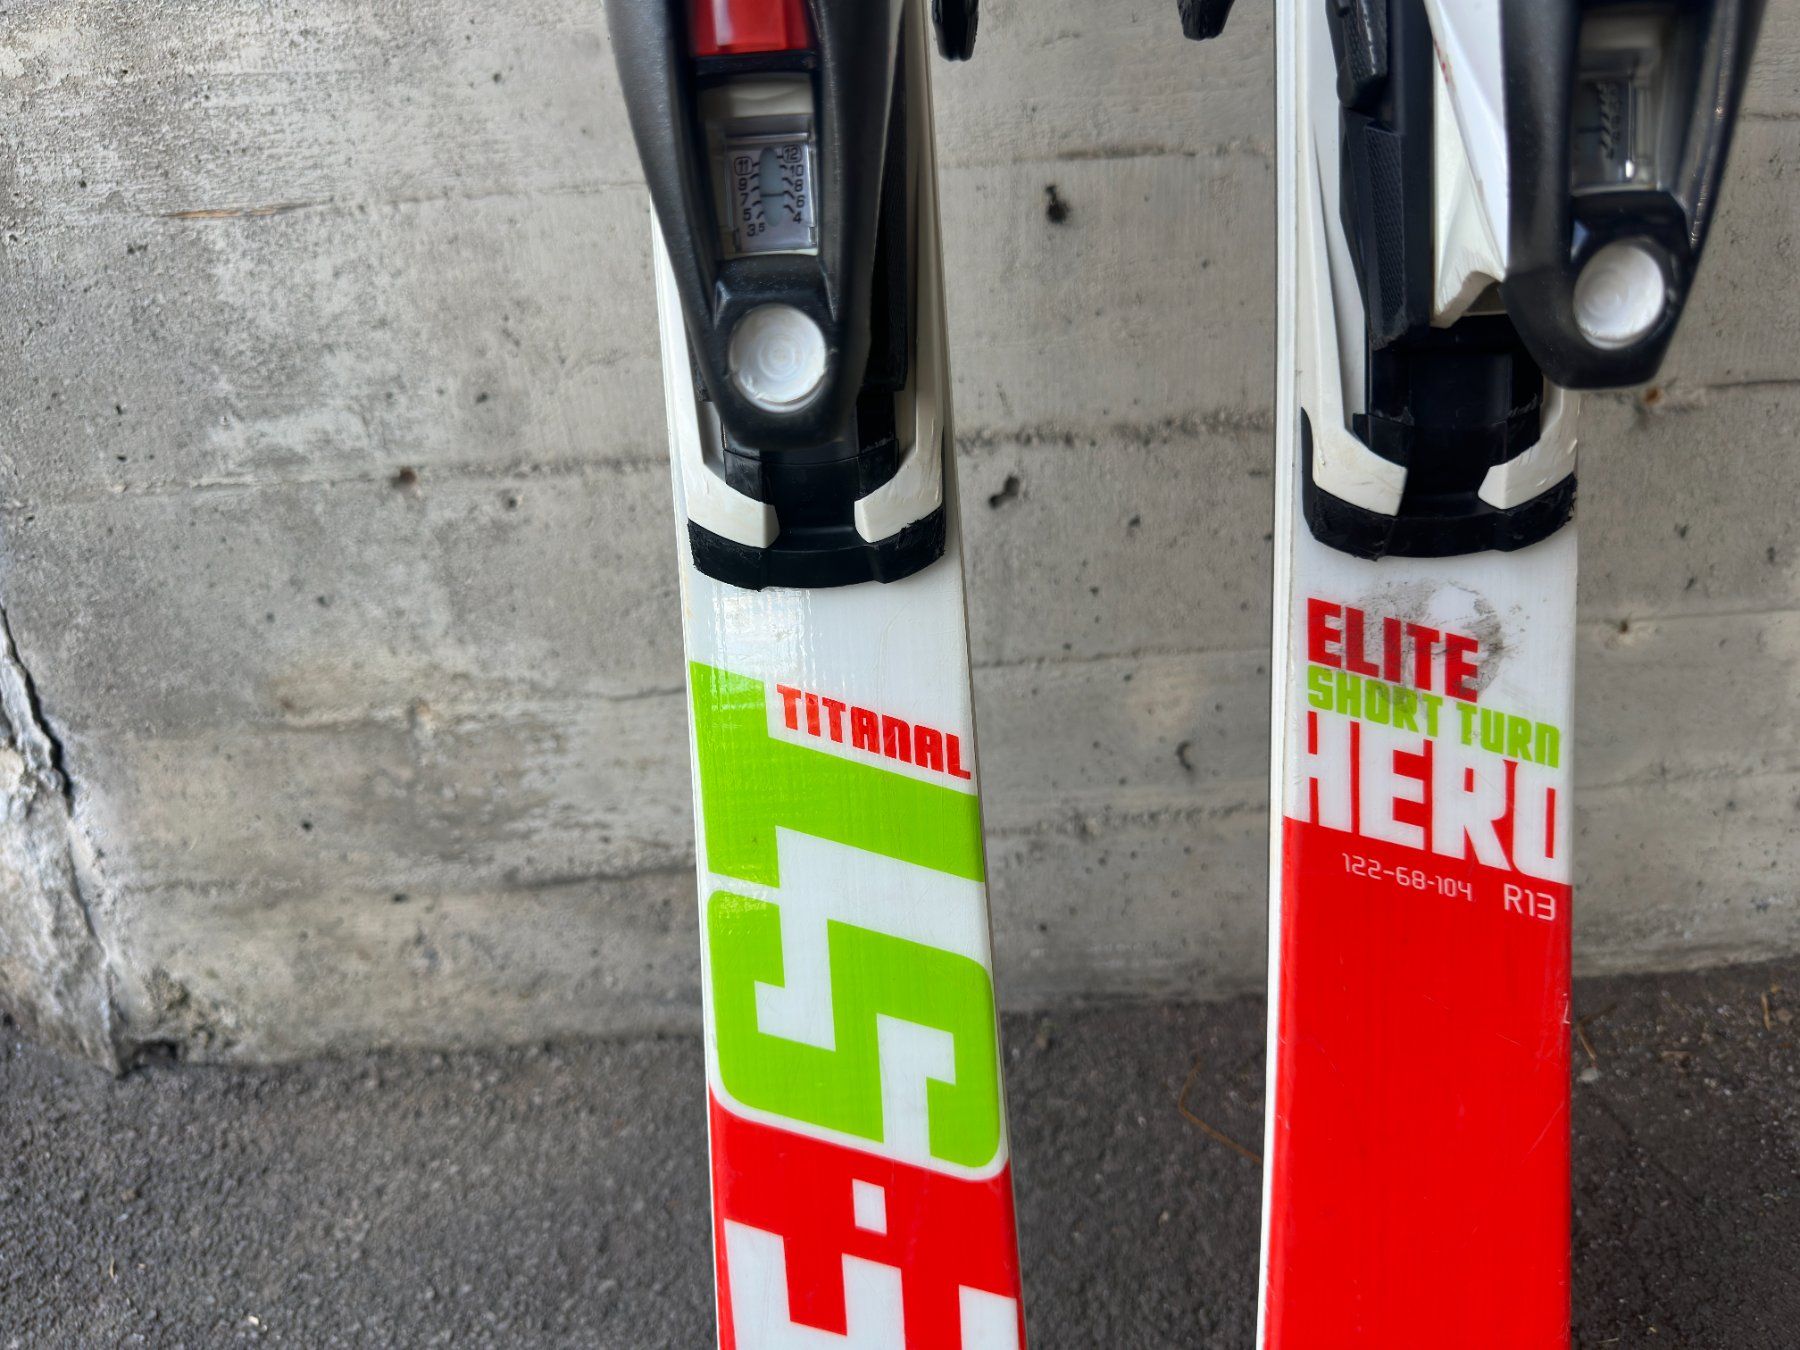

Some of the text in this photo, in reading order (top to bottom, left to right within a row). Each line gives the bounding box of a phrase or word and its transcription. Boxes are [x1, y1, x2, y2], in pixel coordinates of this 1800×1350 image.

[738, 178, 748, 191] 9
[790, 165, 804, 176] 10
[795, 179, 804, 192] 8
[793, 211, 802, 224] 4
[797, 195, 805, 208] 6
[1307, 597, 1478, 703] ELITE
[777, 684, 971, 780] TITANAL
[1307, 664, 1560, 769] SHORT TURN
[1285, 706, 1572, 885] HERO
[1342, 852, 1557, 922] 122-68-104 R13
